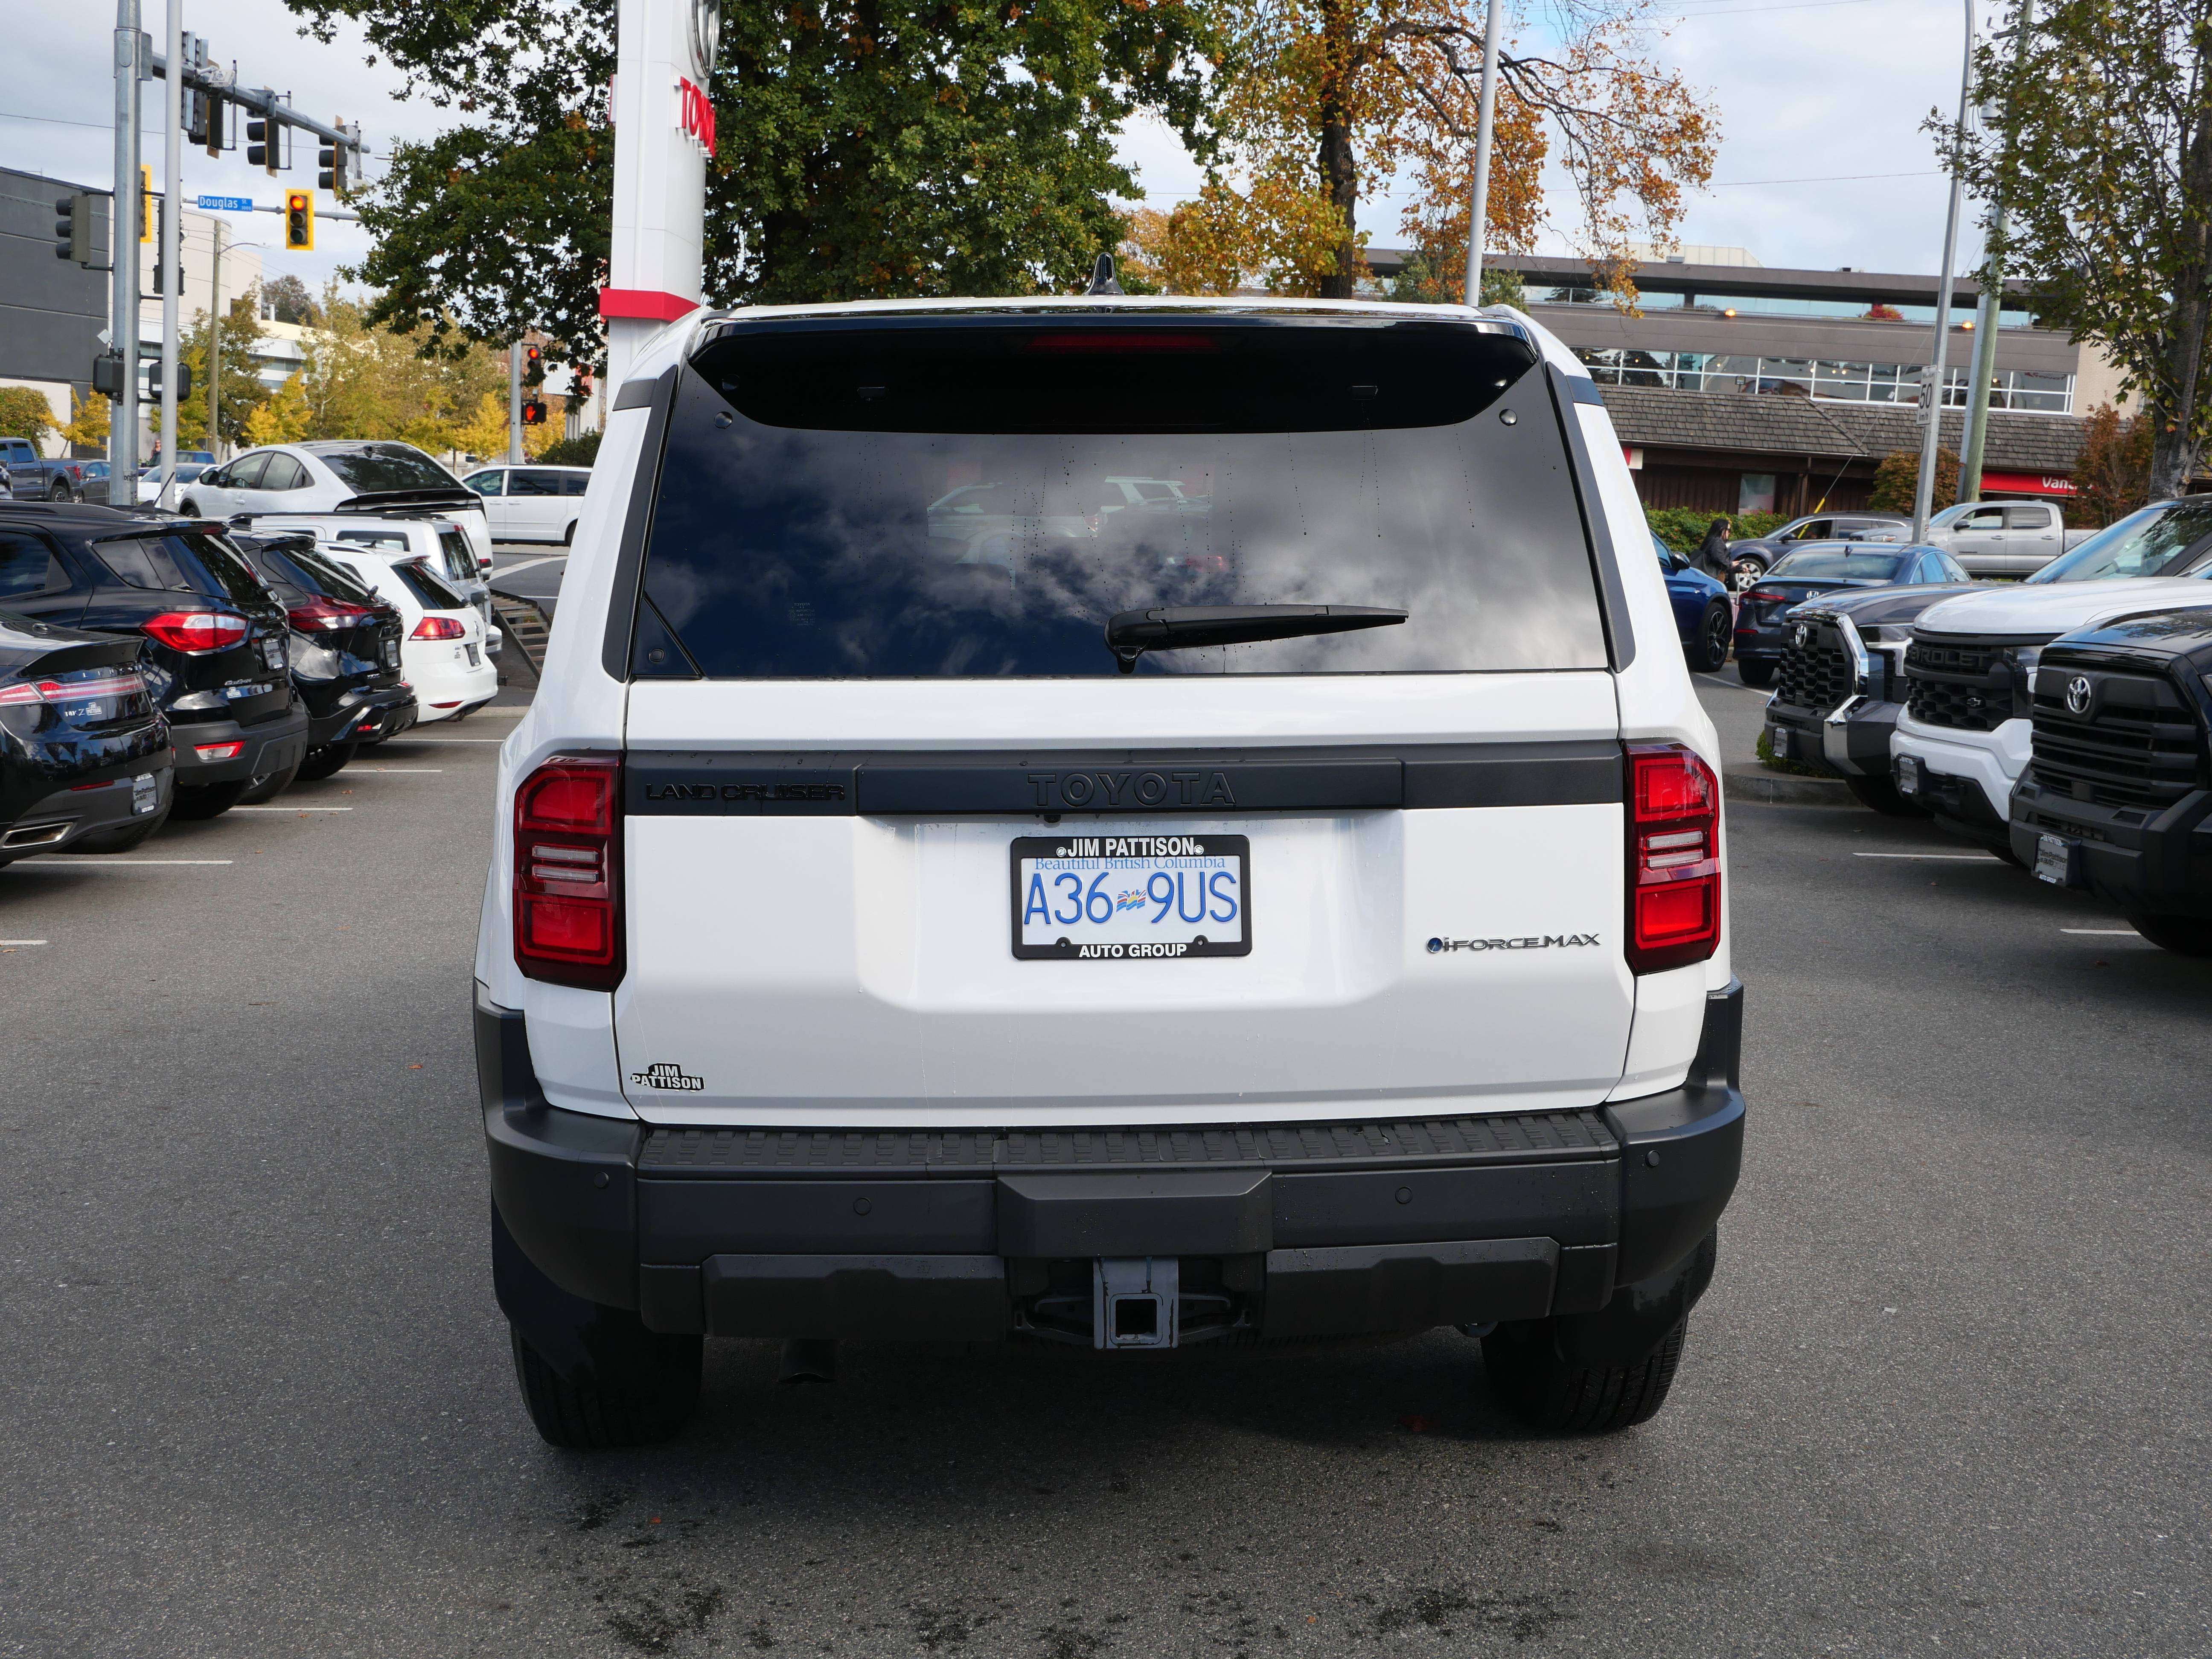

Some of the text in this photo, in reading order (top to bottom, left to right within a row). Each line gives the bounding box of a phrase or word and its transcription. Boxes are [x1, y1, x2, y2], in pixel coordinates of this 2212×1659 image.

[680, 76, 716, 157] TOYO
[200, 196, 238, 210] Douglas
[1920, 383, 1932, 409] 50
[1919, 412, 1929, 421] km/h
[646, 783, 845, 800] LAND CRUISER
[1027, 772, 1237, 808] TOYOTA
[1068, 837, 1194, 857] JIM PATTISON
[1035, 856, 1225, 870] Beautiful British Columbia
[1025, 871, 1237, 925] A36 9US
[1079, 944, 1187, 958] AUTO GROUP
[652, 1065, 678, 1077] JIM
[632, 1074, 701, 1089] PATTISON
